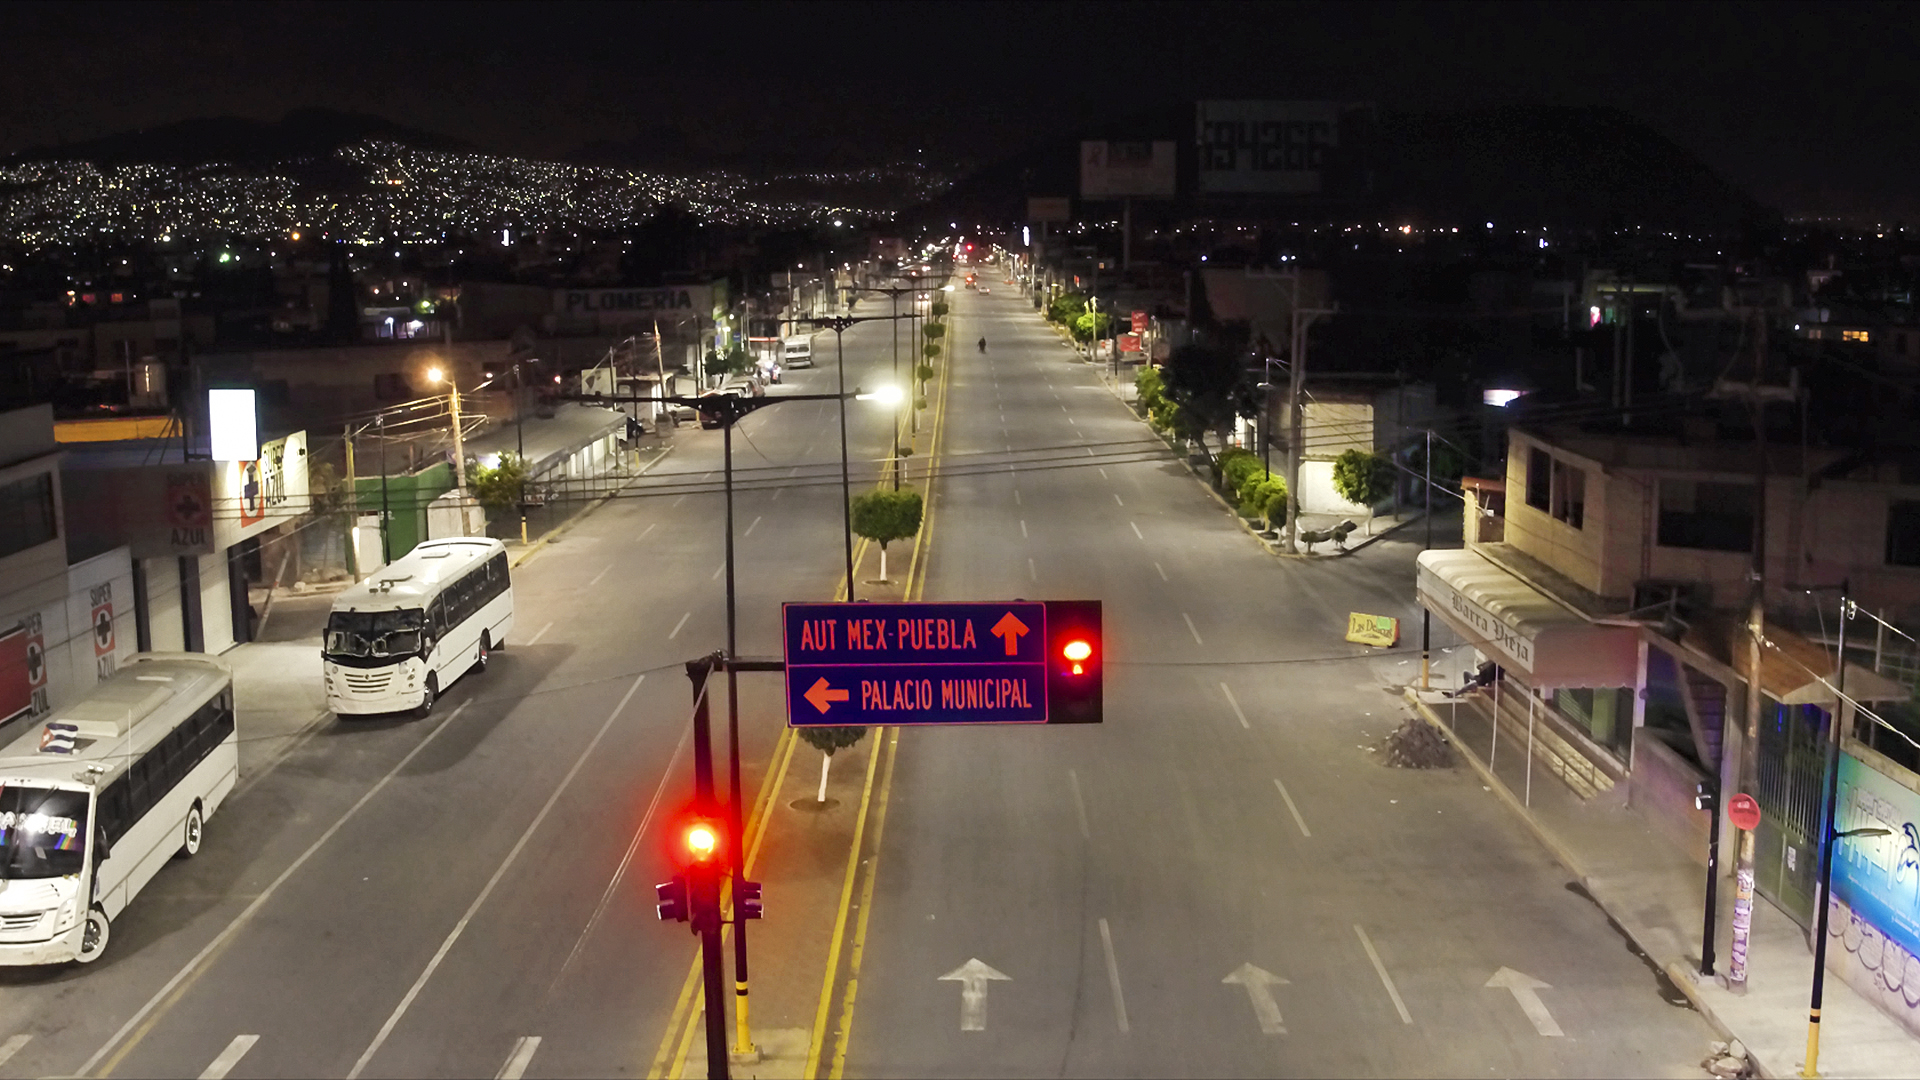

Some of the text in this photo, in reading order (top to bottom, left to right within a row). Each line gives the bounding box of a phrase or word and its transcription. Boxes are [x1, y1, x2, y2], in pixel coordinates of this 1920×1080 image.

[567, 289, 692, 312] PLOMERIA
[265, 470, 288, 508] AZUL
[171, 527, 206, 545] AZUL
[90, 582, 112, 608] SUPER
[801, 618, 976, 651] AUT MEX-PUEBLA
[1451, 590, 1529, 662] Barra Vieja
[861, 678, 1032, 711] PALACIO MUNICIPAL
